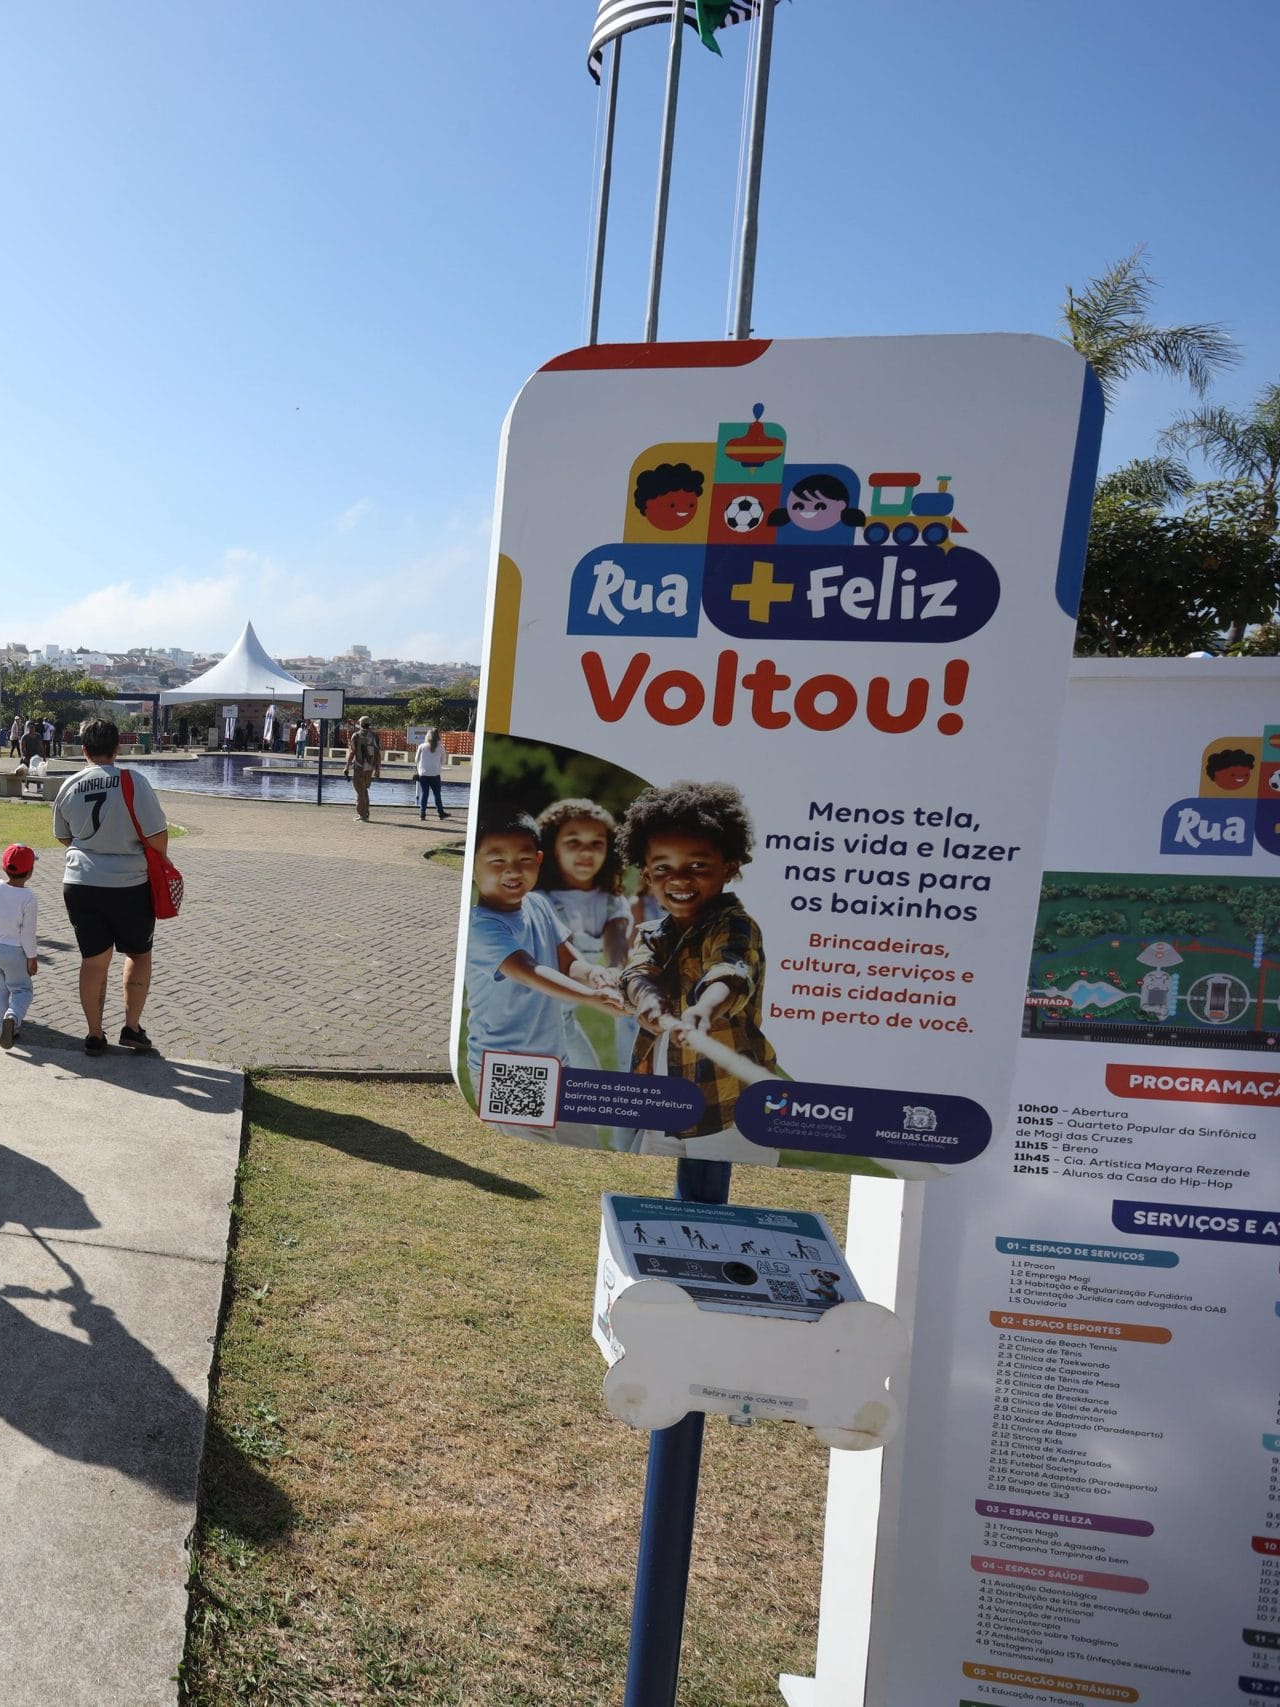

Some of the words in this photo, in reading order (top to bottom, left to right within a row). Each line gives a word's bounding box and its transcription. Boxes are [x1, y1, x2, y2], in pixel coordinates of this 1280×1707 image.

[587, 560, 689, 624] Rua
[806, 556, 958, 620] Feliz
[580, 649, 970, 736] Voltou!
[84, 792, 107, 834] 7
[809, 802, 904, 825] Menos
[913, 807, 979, 832] tela,
[1174, 808, 1246, 848] Rua
[766, 831, 834, 852] mais
[844, 834, 907, 856] vida
[917, 842, 934, 857] e
[944, 838, 1020, 861] lazer
[785, 866, 835, 882] nas
[845, 869, 910, 886] ruas
[919, 873, 990, 893] para
[791, 896, 822, 912] os
[831, 892, 977, 921] baixinhos
[809, 933, 949, 958] Brincadeiras,
[781, 957, 860, 977] cultura,
[867, 964, 955, 983] serviços
[962, 972, 974, 982] e
[792, 983, 841, 998] mais
[848, 985, 956, 1006] cidadania
[1026, 998, 1070, 1006] ENTRADA
[770, 1003, 815, 1020] bem
[822, 1011, 880, 1025] perto
[886, 1013, 912, 1028] de
[919, 1017, 973, 1033] você.
[566, 1080, 599, 1089] Confira
[614, 1084, 640, 1093] datas
[565, 1092, 597, 1100] bairros
[645, 1099, 692, 1109] Prefeitura
[615, 1108, 640, 1116] Code.
[791, 1102, 854, 1122] MOGI
[1018, 1104, 1058, 1114] 10h00
[1072, 1108, 1128, 1118] Abertura
[876, 1130, 900, 1139] MOGI
[902, 1133, 920, 1141] DAS
[922, 1134, 959, 1144] CRUZES
[1017, 1116, 1053, 1126] 10h15
[1067, 1119, 1123, 1130] Quarteto
[1127, 1123, 1176, 1134] Popular
[1199, 1128, 1256, 1139] Sinfônica
[1034, 1130, 1062, 1142] Mogi
[1066, 1132, 1088, 1141] das
[1092, 1134, 1133, 1144] Cruzes
[1015, 1140, 1048, 1150] 11h15
[1062, 1144, 1098, 1154] Breno
[1014, 1153, 1050, 1162] 11h45
[1064, 1156, 1085, 1165] Cia.
[1145, 1162, 1192, 1173] Mayara
[1197, 1166, 1250, 1177] Rezende
[1013, 1165, 1048, 1175] 12h15
[1062, 1168, 1103, 1179] Alunos
[1107, 1172, 1122, 1180] da
[1127, 1173, 1157, 1183] Casa
[1161, 1176, 1176, 1184] do
[1180, 1177, 1232, 1190] Hip-Hop
[1133, 1210, 1240, 1233] SERVIÇOS
[1245, 1219, 1257, 1233] E
[1262, 1220, 1280, 1235] A
[1030, 1244, 1072, 1255] ESPAÇO
[1074, 1248, 1088, 1256] DE
[1091, 1250, 1144, 1261] SERVIÇOS
[1024, 1262, 1055, 1270] Procon
[1026, 1271, 1066, 1282] Emprega
[1069, 1275, 1090, 1284] Mogi
[1023, 1297, 1067, 1307] Ouvidoria
[1024, 1289, 1074, 1300] Orientação
[1137, 1300, 1187, 1310] advogados
[1082, 1284, 1146, 1297] Regularização
[1148, 1291, 1192, 1301] Fundiária
[1023, 1319, 1064, 1329] ESPAÇO
[1067, 1323, 1120, 1335] ESPORTES
[703, 1388, 726, 1397] Retire
[1009, 1508, 1050, 1520] ESPAÇO
[1053, 1514, 1092, 1525] BELEZA
[1005, 1564, 1045, 1576] ESPAÇO
[1048, 1570, 1083, 1581] SAÚDE
[996, 1671, 1055, 1686] EDUCAÇÃO
[1057, 1681, 1073, 1689] NO
[1076, 1684, 1129, 1697] TRÂNSITO
